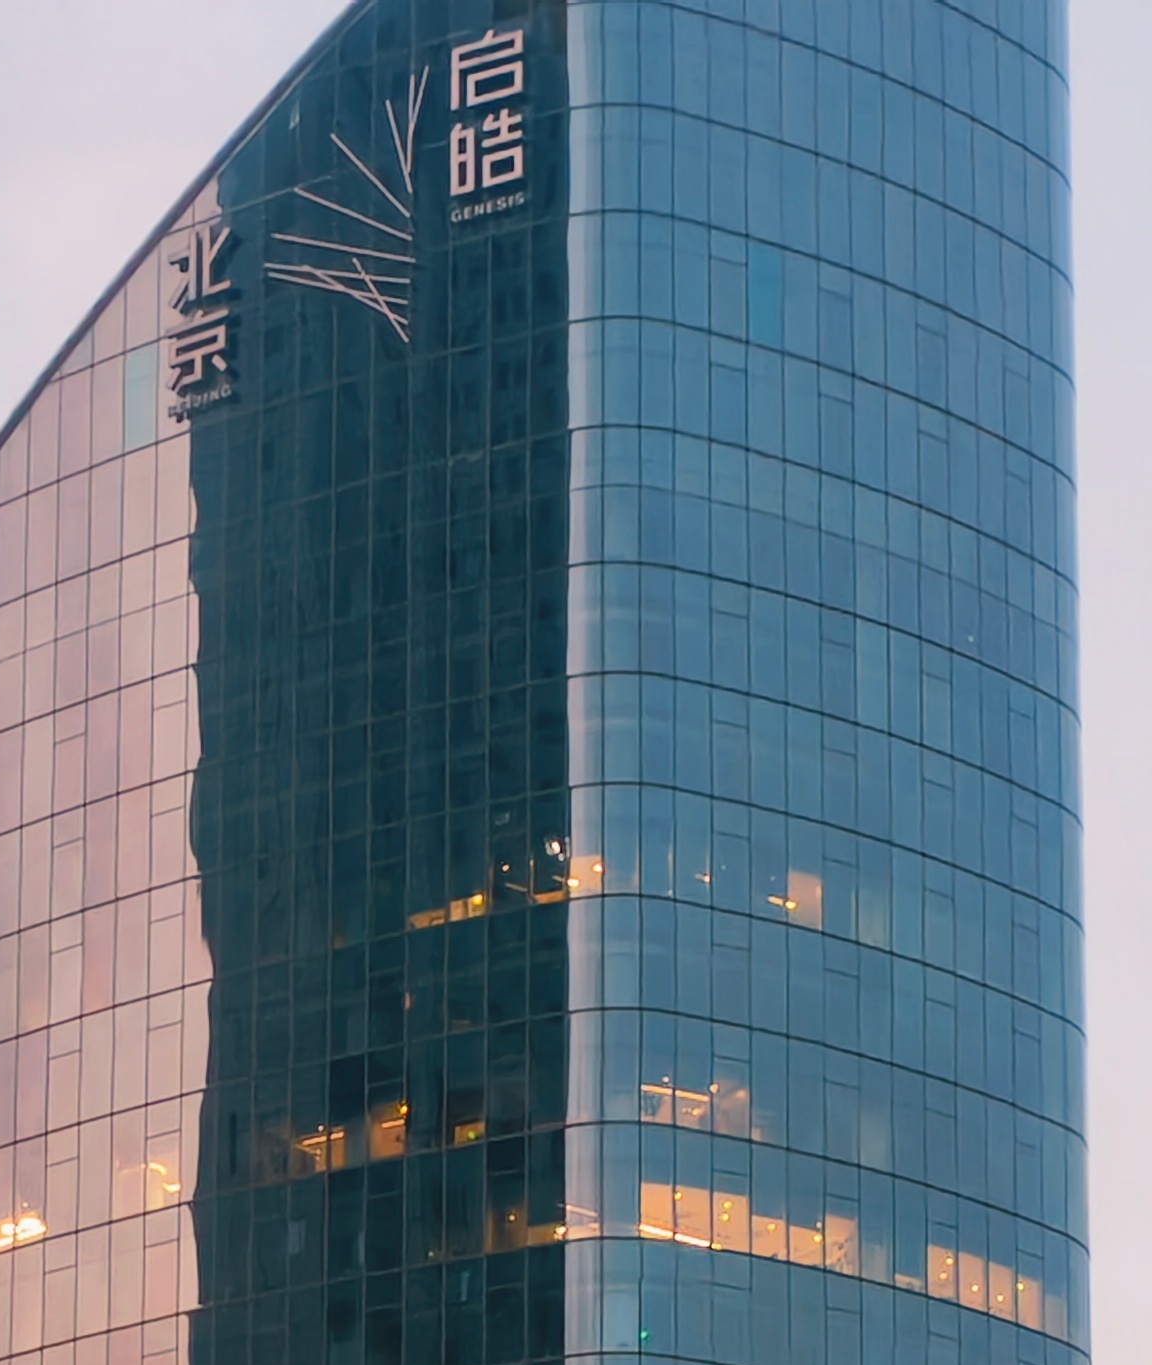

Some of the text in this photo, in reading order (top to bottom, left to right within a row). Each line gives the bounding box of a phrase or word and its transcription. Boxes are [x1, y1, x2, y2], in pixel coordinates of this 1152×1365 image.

[450, 29, 524, 196] 启皓
[451, 192, 524, 222] GENESIS
[167, 226, 230, 391] 北京
